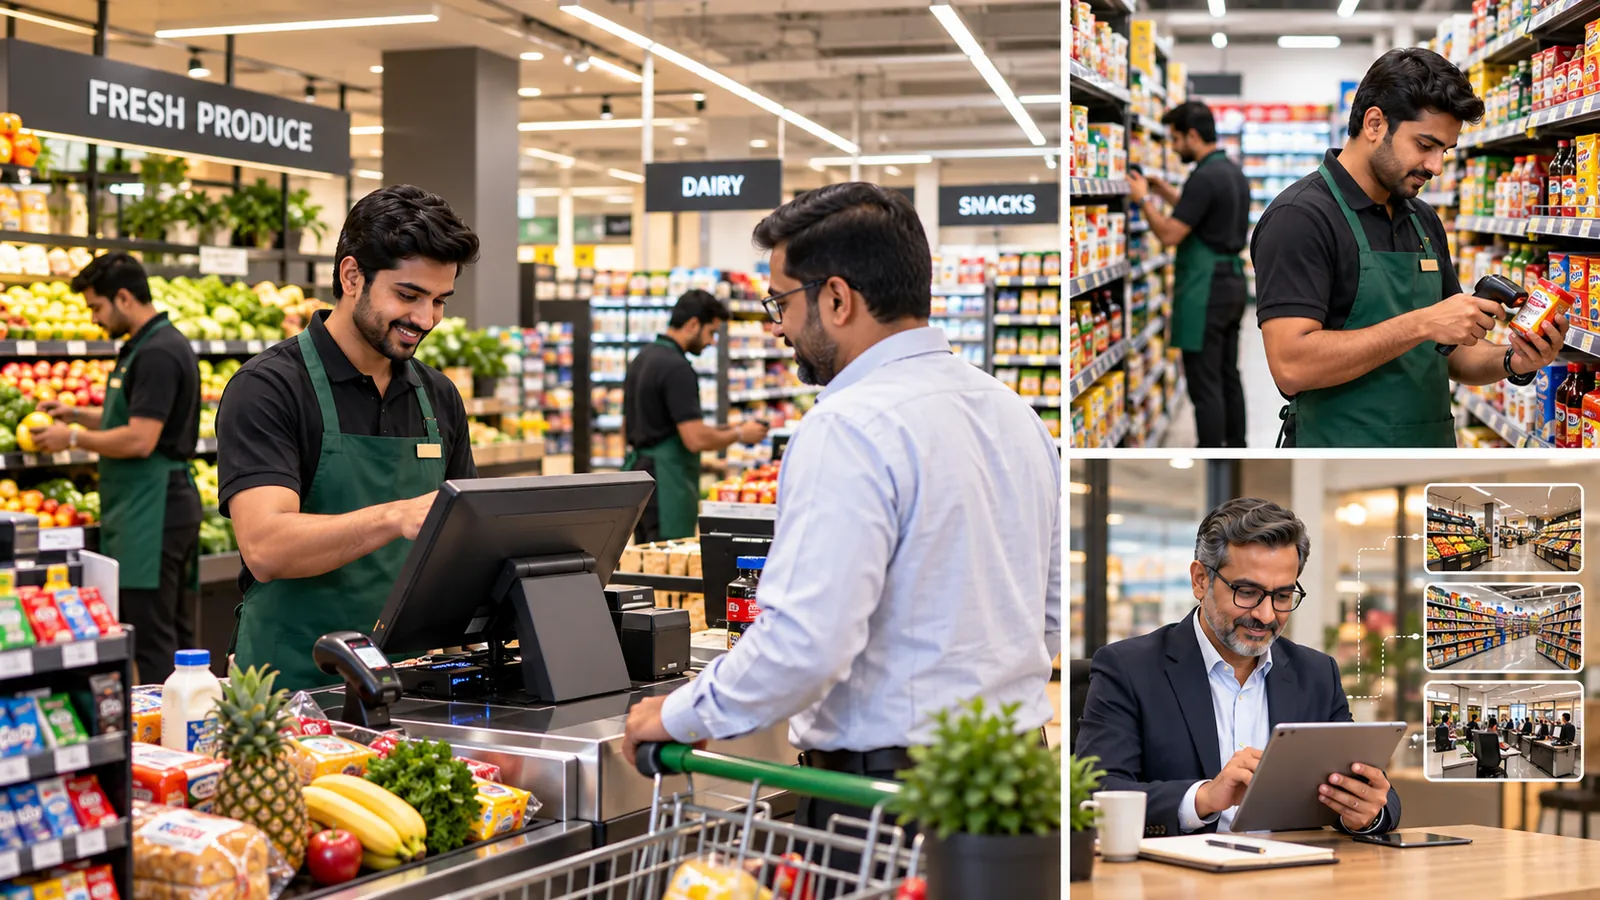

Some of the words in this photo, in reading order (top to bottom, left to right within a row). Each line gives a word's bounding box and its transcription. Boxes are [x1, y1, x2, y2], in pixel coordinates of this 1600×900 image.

[89, 78, 185, 130] FRESH
[197, 100, 313, 153] PRODUCE
[682, 174, 745, 198] DAIRY
[958, 193, 1037, 216] SNACKS
